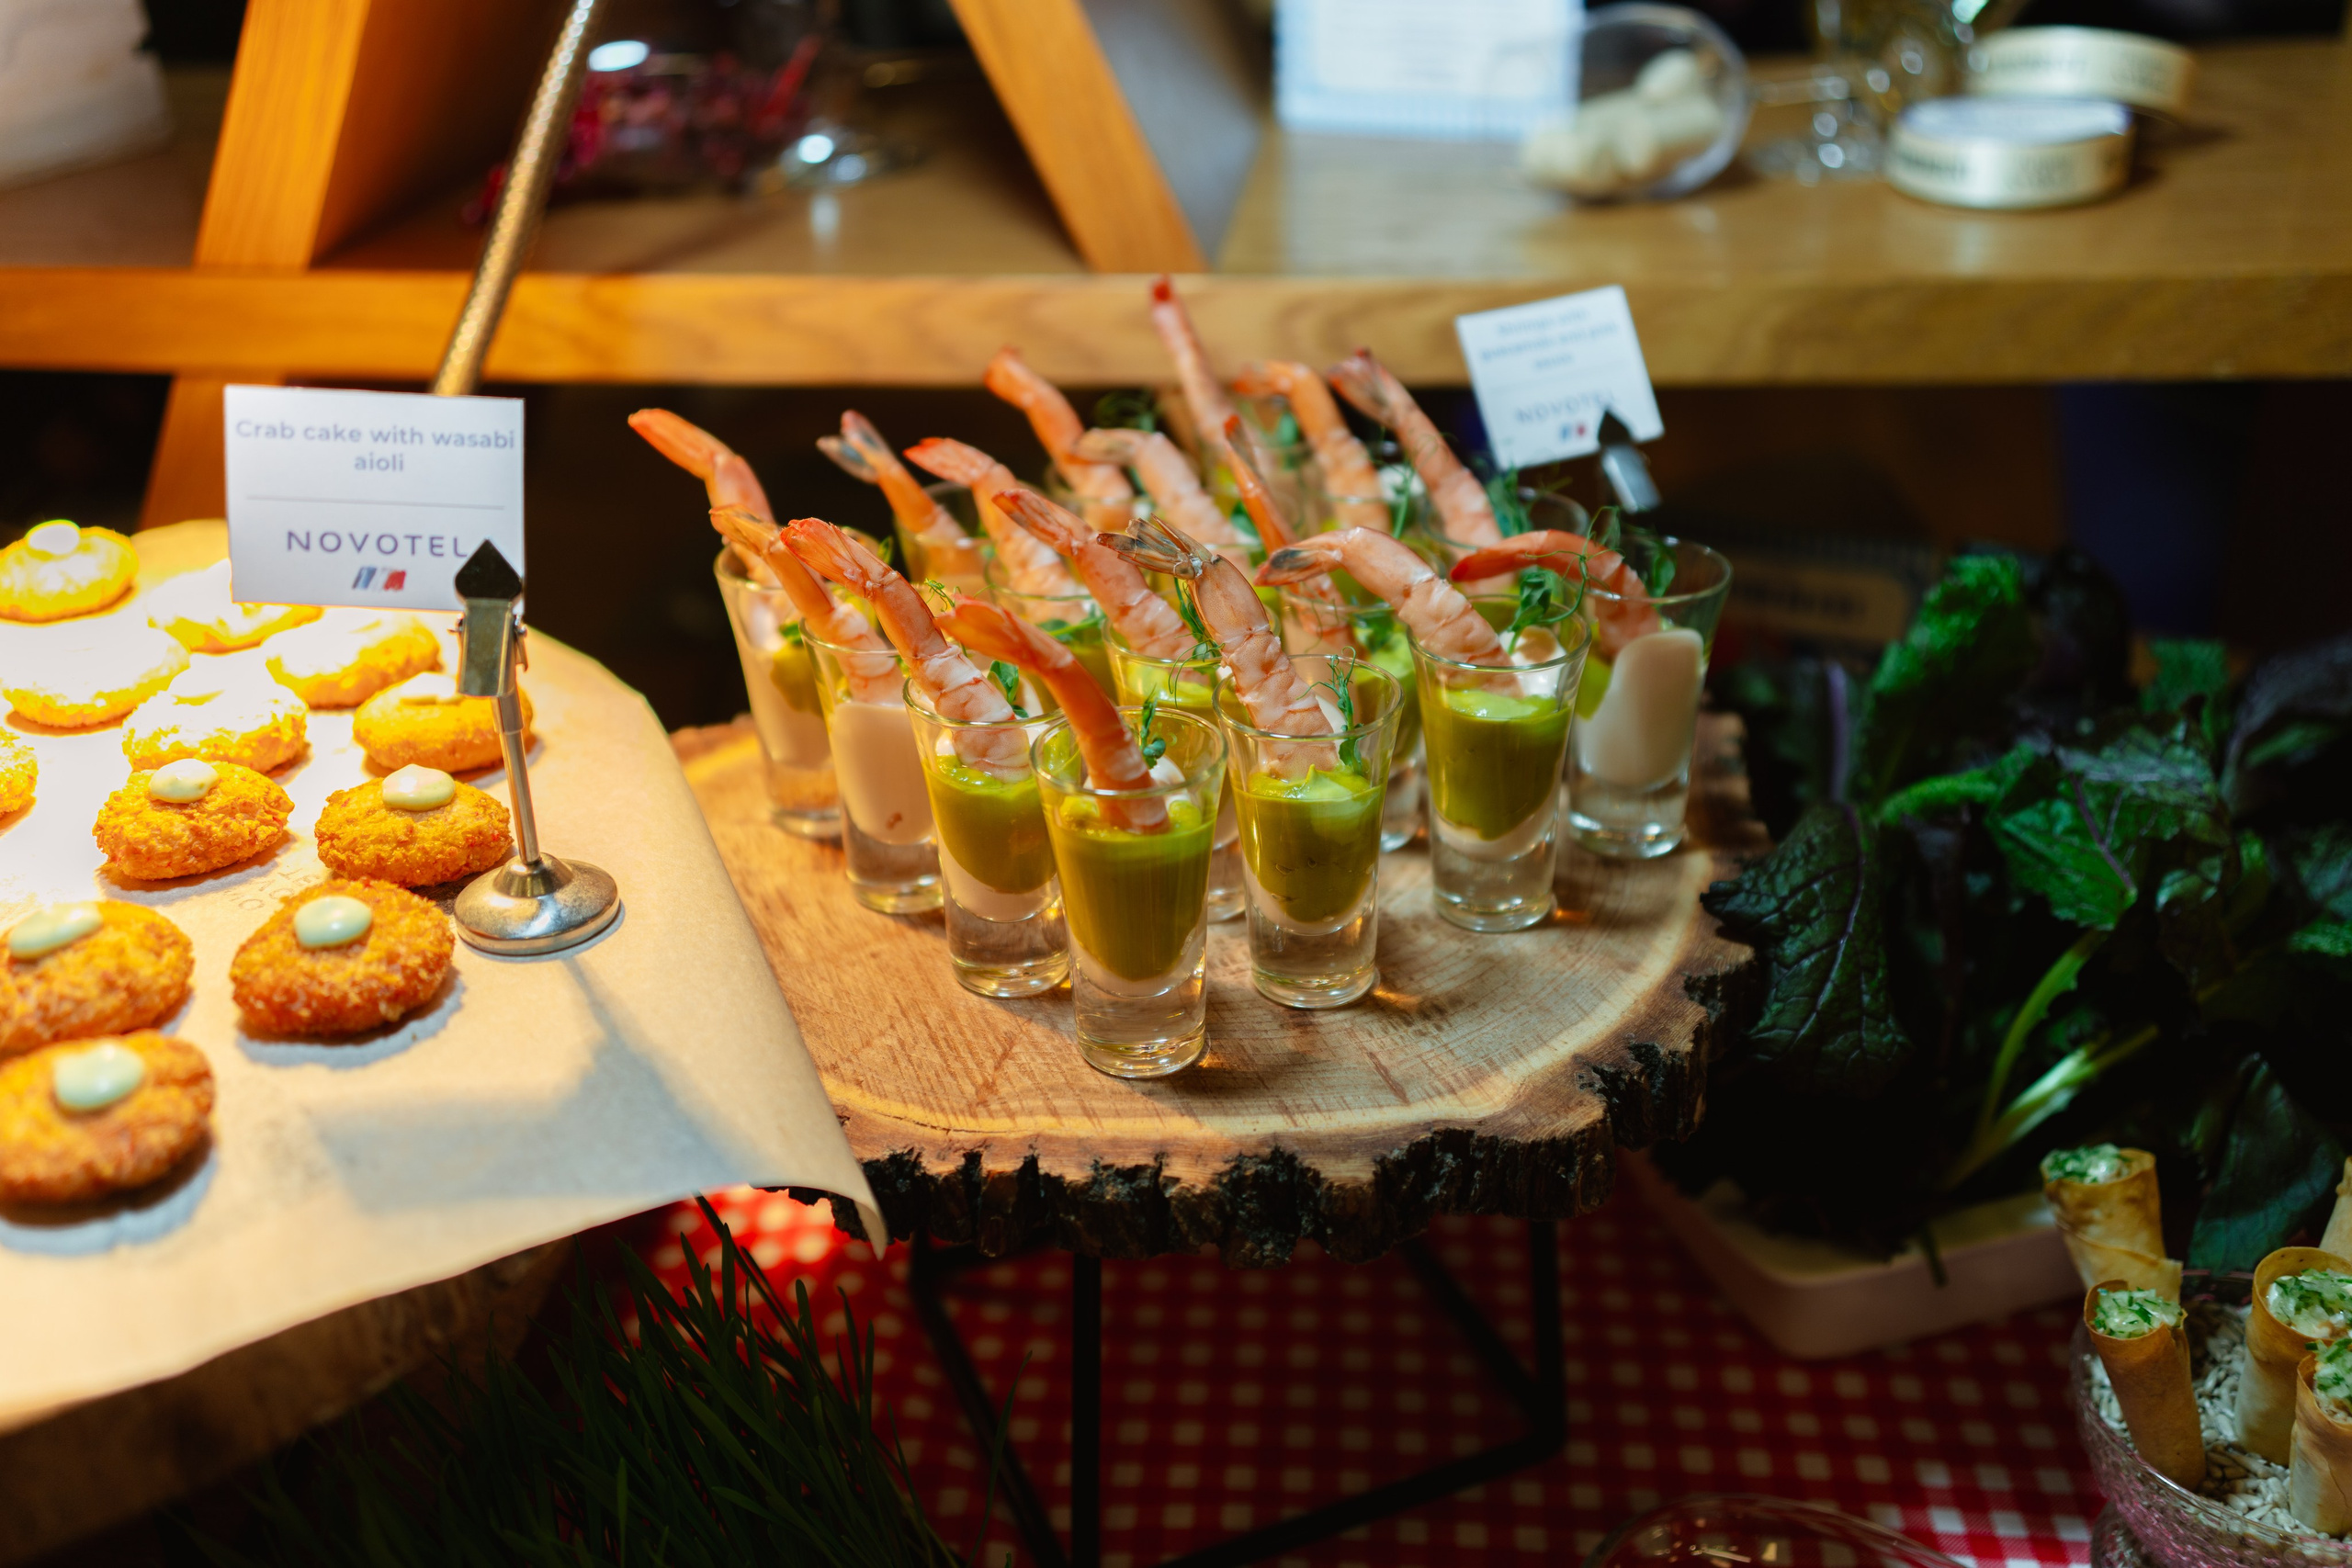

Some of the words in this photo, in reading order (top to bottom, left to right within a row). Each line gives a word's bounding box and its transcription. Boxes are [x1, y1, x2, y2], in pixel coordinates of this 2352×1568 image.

[235, 420, 295, 440] Crab
[303, 423, 362, 443] cake
[369, 424, 424, 446] with
[432, 429, 515, 449] wasabi
[354, 453, 404, 472] aioli
[287, 530, 469, 558] NOVOTEL
